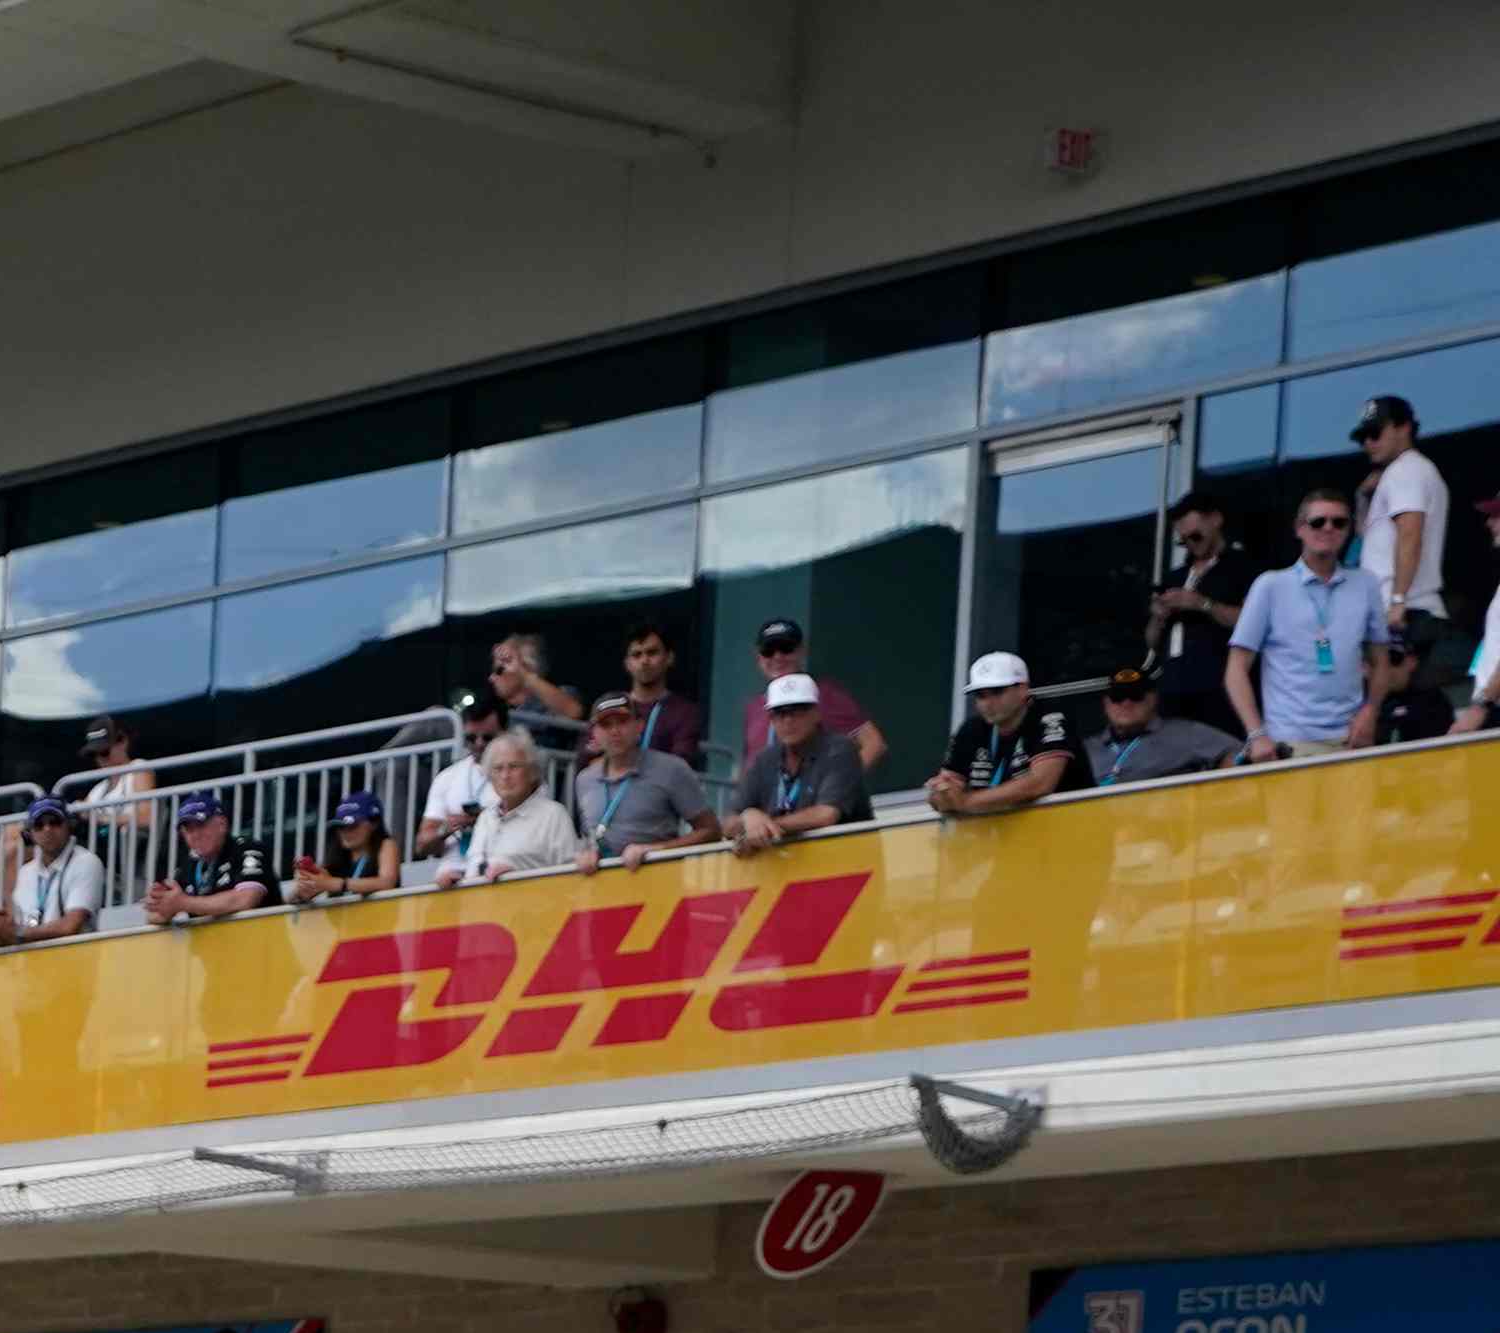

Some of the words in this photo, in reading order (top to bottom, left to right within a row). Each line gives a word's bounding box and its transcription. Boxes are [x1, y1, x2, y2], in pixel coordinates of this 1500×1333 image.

[302, 871, 906, 1077] DHL
[784, 1184, 855, 1254] 18
[1178, 1280, 1325, 1314] ESTEBAN
